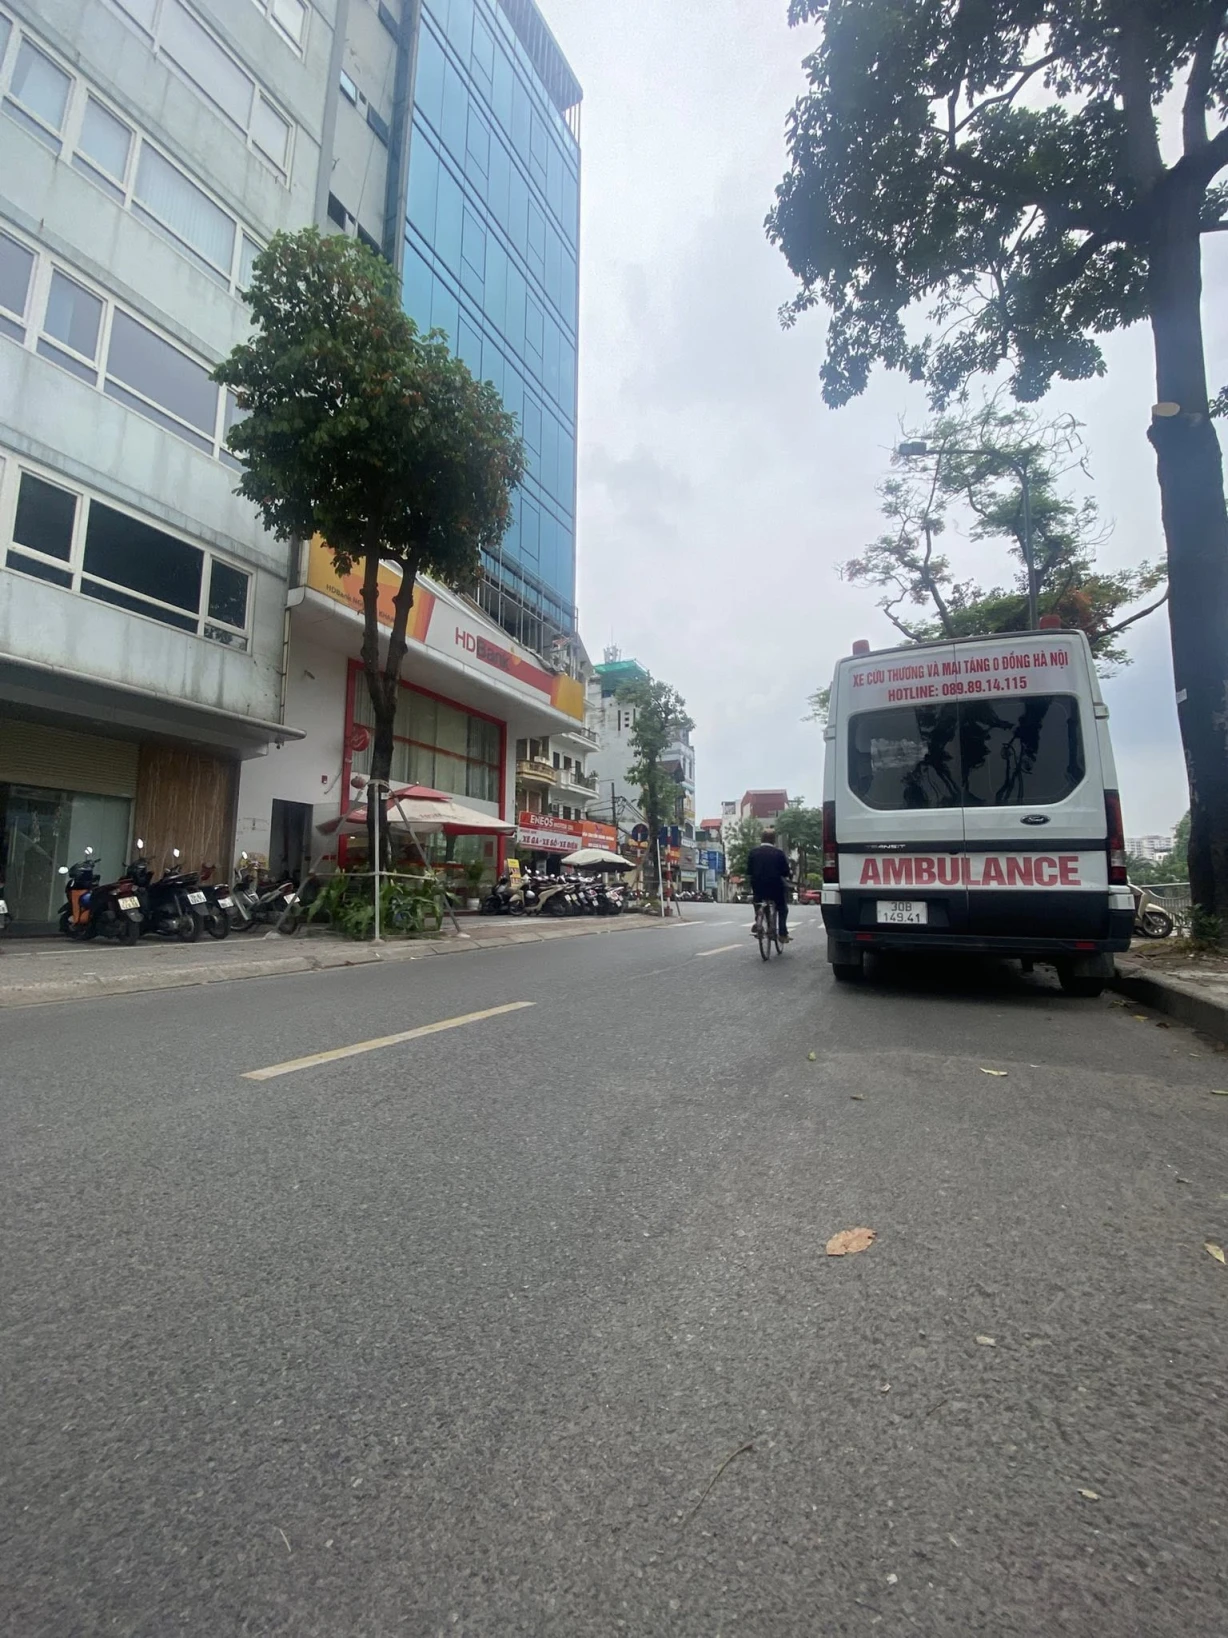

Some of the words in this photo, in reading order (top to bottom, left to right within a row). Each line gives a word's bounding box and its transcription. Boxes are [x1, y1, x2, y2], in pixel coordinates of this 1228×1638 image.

[853, 673, 865, 688] XE
[887, 665, 925, 682] THƯƠNG
[927, 661, 940, 678] VÀ
[942, 661, 962, 676] MAI
[964, 657, 991, 674] TÁNG
[1033, 650, 1048, 667] HÀ
[1050, 649, 1069, 669] NỘI
[888, 685, 939, 702] HOTLINE:
[942, 676, 1028, 696] 089.89.14.115
[530, 814, 555, 827] ENEOS
[860, 855, 1081, 886] AMBULANCE
[891, 902, 912, 912] 30B
[884, 912, 920, 922] 149.41
